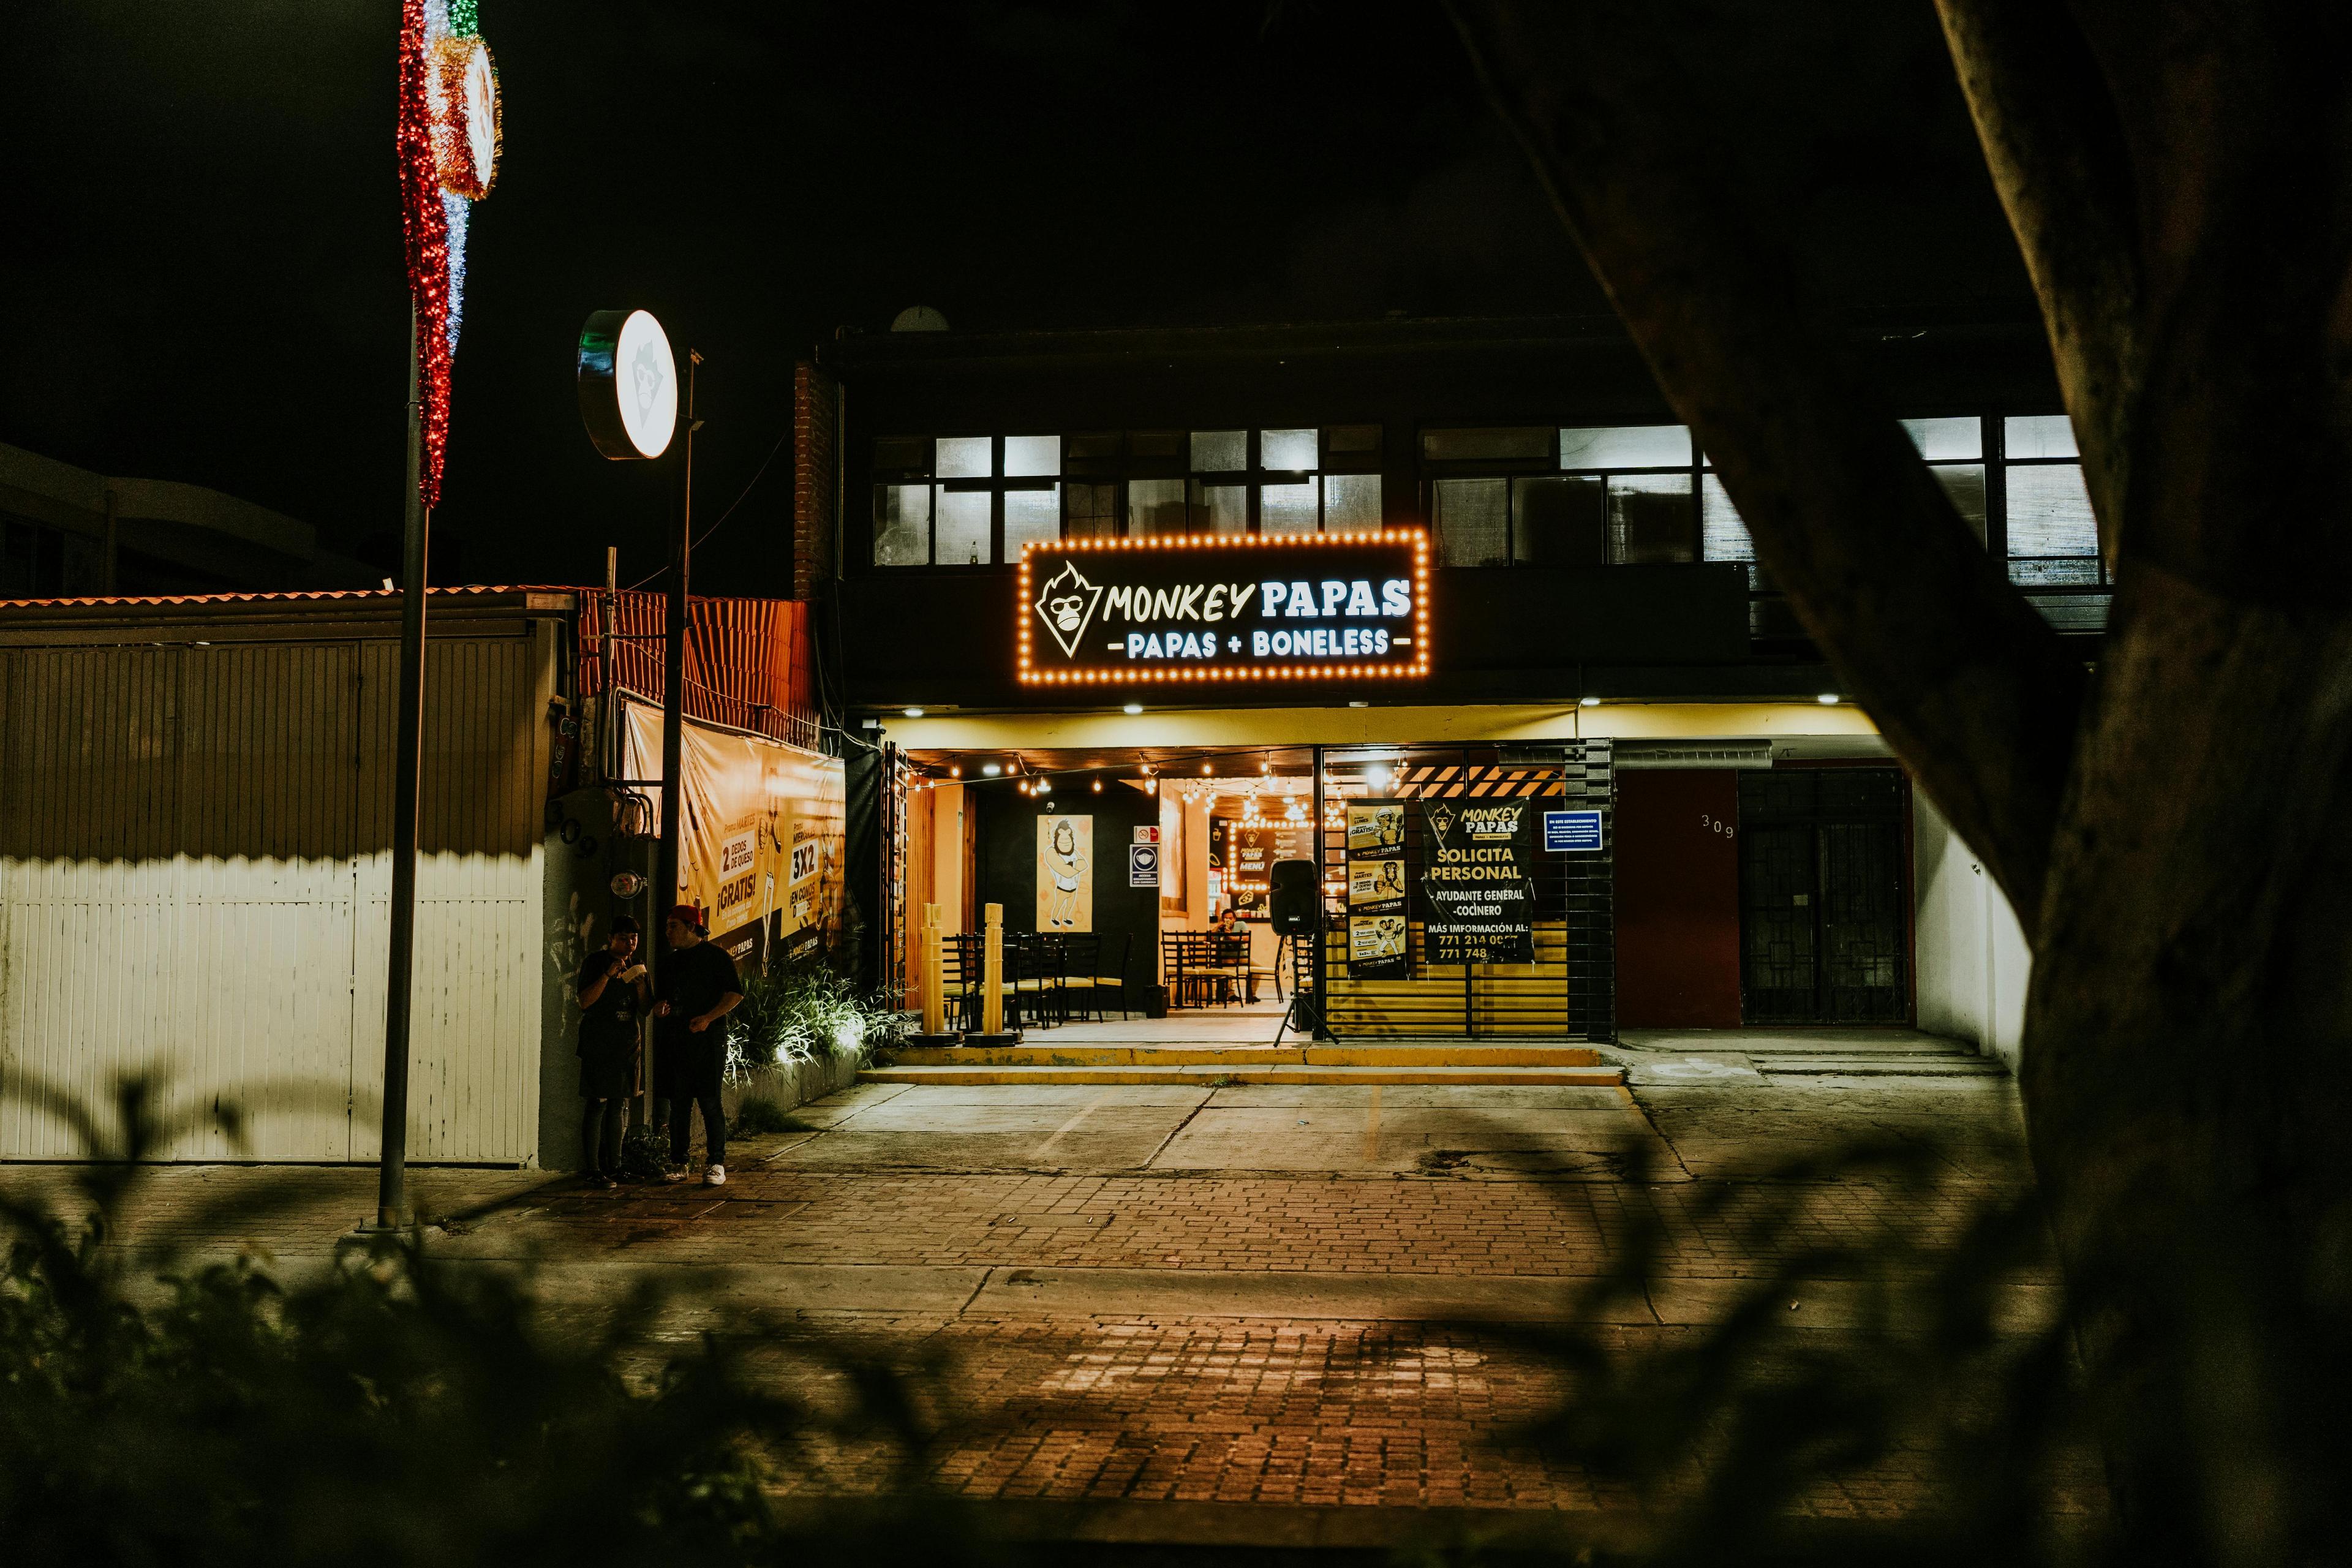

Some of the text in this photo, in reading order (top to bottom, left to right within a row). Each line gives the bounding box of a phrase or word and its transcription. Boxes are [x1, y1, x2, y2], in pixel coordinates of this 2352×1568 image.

[1103, 579, 1411, 622] MONKEY PAPAS
[1128, 629, 1389, 658] PAPAS + BONELESS
[736, 813, 755, 831] MARTES
[1460, 807, 1523, 822] MONKEY
[1349, 826, 1373, 835] ¡GRATIS!
[1465, 821, 1518, 833] PAPAS
[1702, 815, 1733, 839] 309
[723, 840, 747, 872] 2 DEDOS
[731, 851, 753, 869] DE QUESO
[793, 844, 815, 880] 3X2
[1438, 848, 1514, 862] SOLICITA
[1239, 861, 1265, 870] MENÚ
[1431, 866, 1522, 880] PERSONAL
[717, 872, 756, 918] ¡GRATIS!
[798, 881, 815, 901] CONOS
[1436, 891, 1482, 901] AYUDANTE
[1484, 889, 1524, 901] GENERAL
[1428, 922, 1529, 933] MÁS IMFORMACIÓN AL:
[737, 938, 753, 954] PAPAS
[805, 936, 818, 951] PAPAS
[1439, 935, 1459, 945] 771
[1464, 935, 1487, 944] 214
[1439, 948, 1487, 959] 771 748
